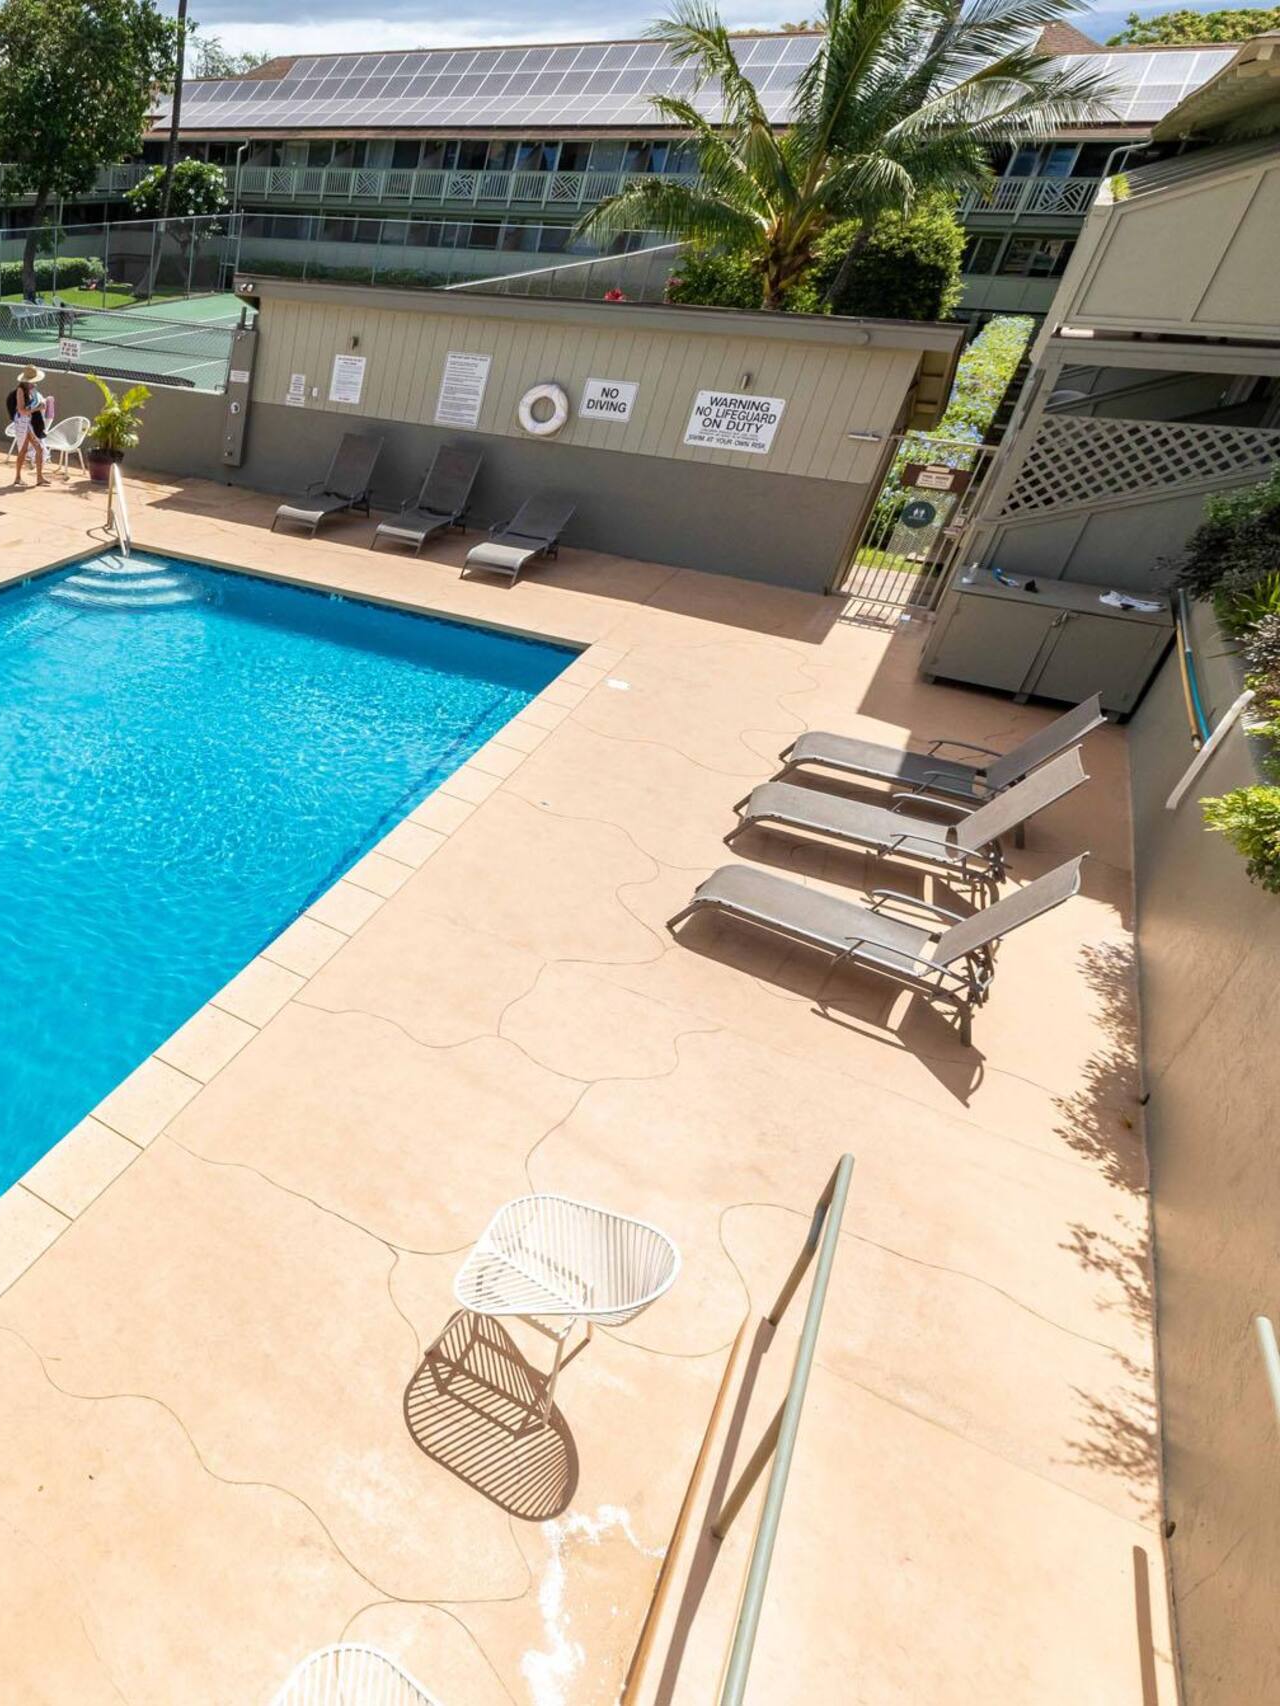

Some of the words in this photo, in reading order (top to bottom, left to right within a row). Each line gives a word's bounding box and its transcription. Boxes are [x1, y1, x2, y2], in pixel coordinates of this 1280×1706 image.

[601, 387, 619, 399] NO
[586, 398, 627, 413] DIVING
[710, 396, 771, 412] WARNING
[695, 406, 712, 417] NO
[715, 408, 777, 424] LIFEGUARD
[702, 417, 722, 429] ON
[726, 420, 763, 433] DUTY
